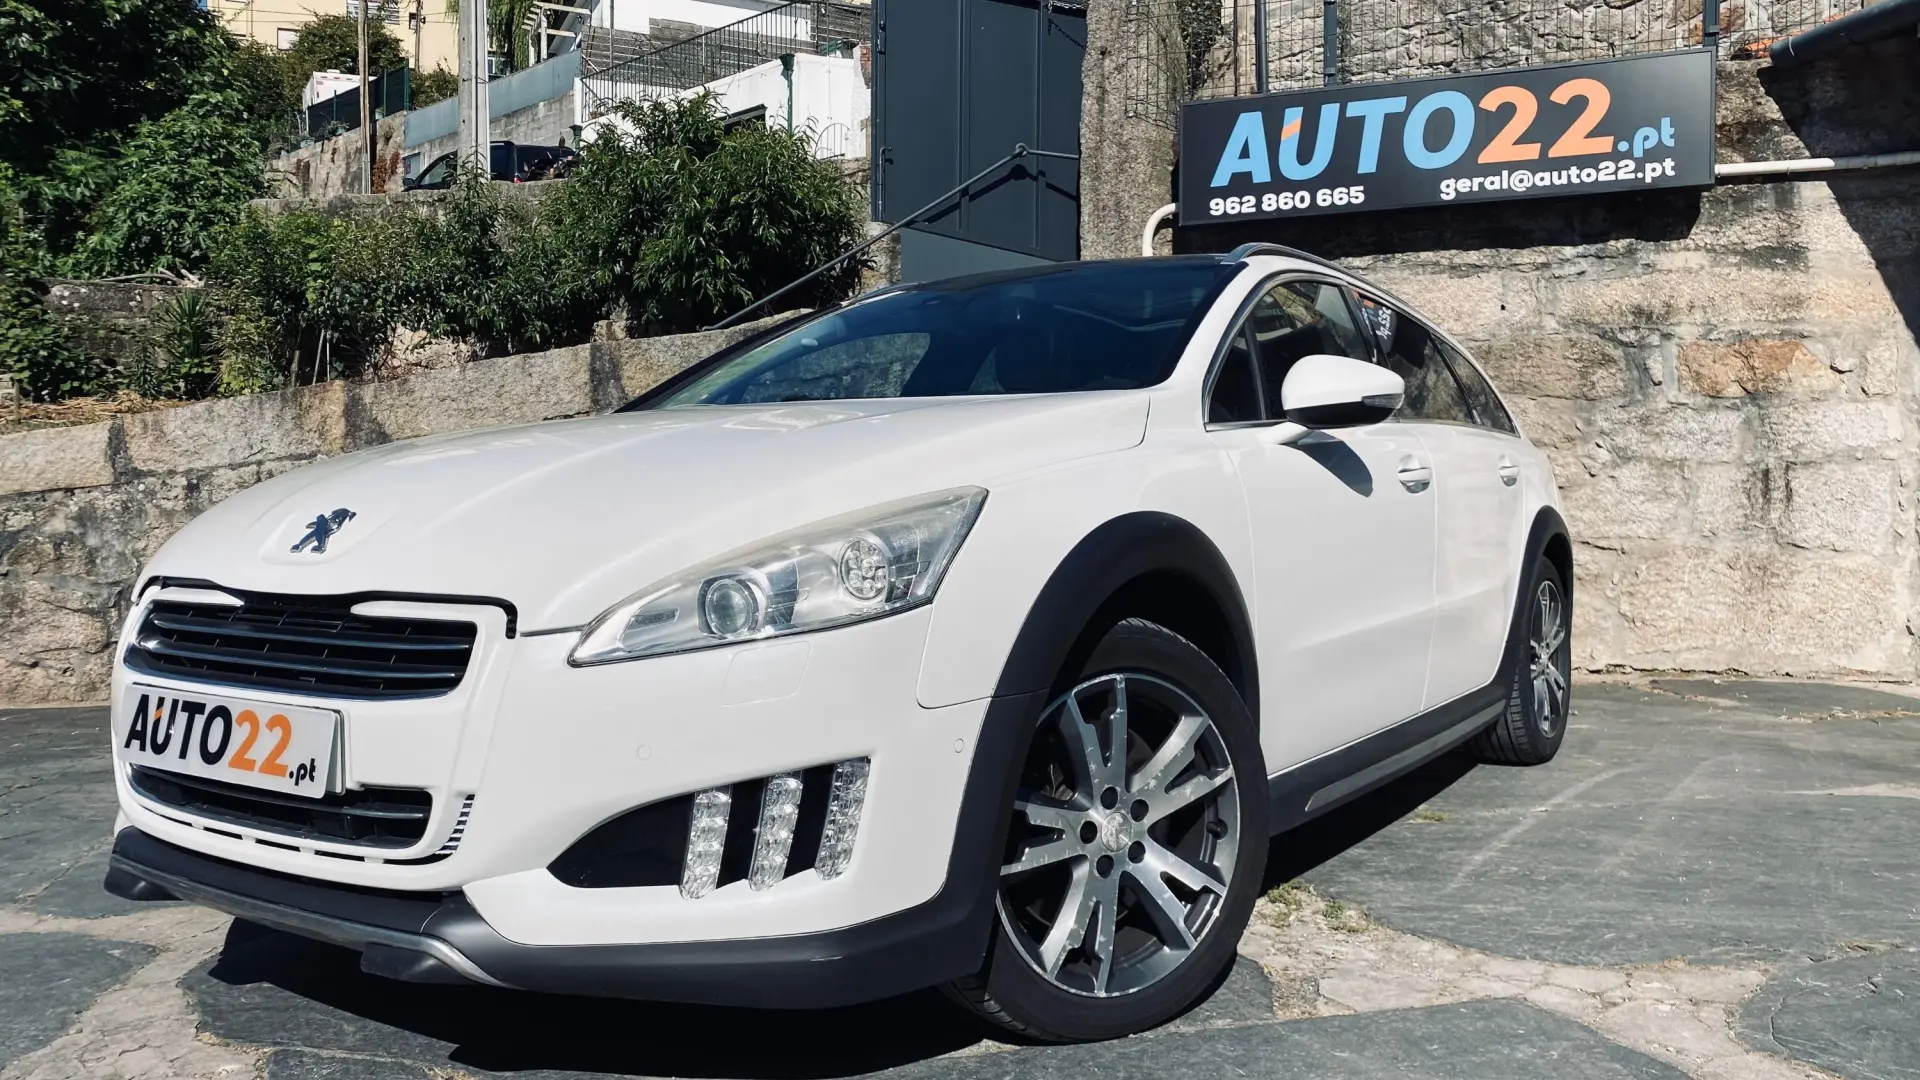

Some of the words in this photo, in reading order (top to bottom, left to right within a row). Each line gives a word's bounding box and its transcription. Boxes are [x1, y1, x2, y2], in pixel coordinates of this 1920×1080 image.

[1211, 78, 1675, 187] AUTO22.pt
[1209, 197, 1257, 216] 962
[1261, 191, 1311, 212] 860
[1316, 185, 1365, 207] 665
[1440, 158, 1675, 200] geral@auto22.pt
[124, 694, 316, 786] AUTO22.pt
